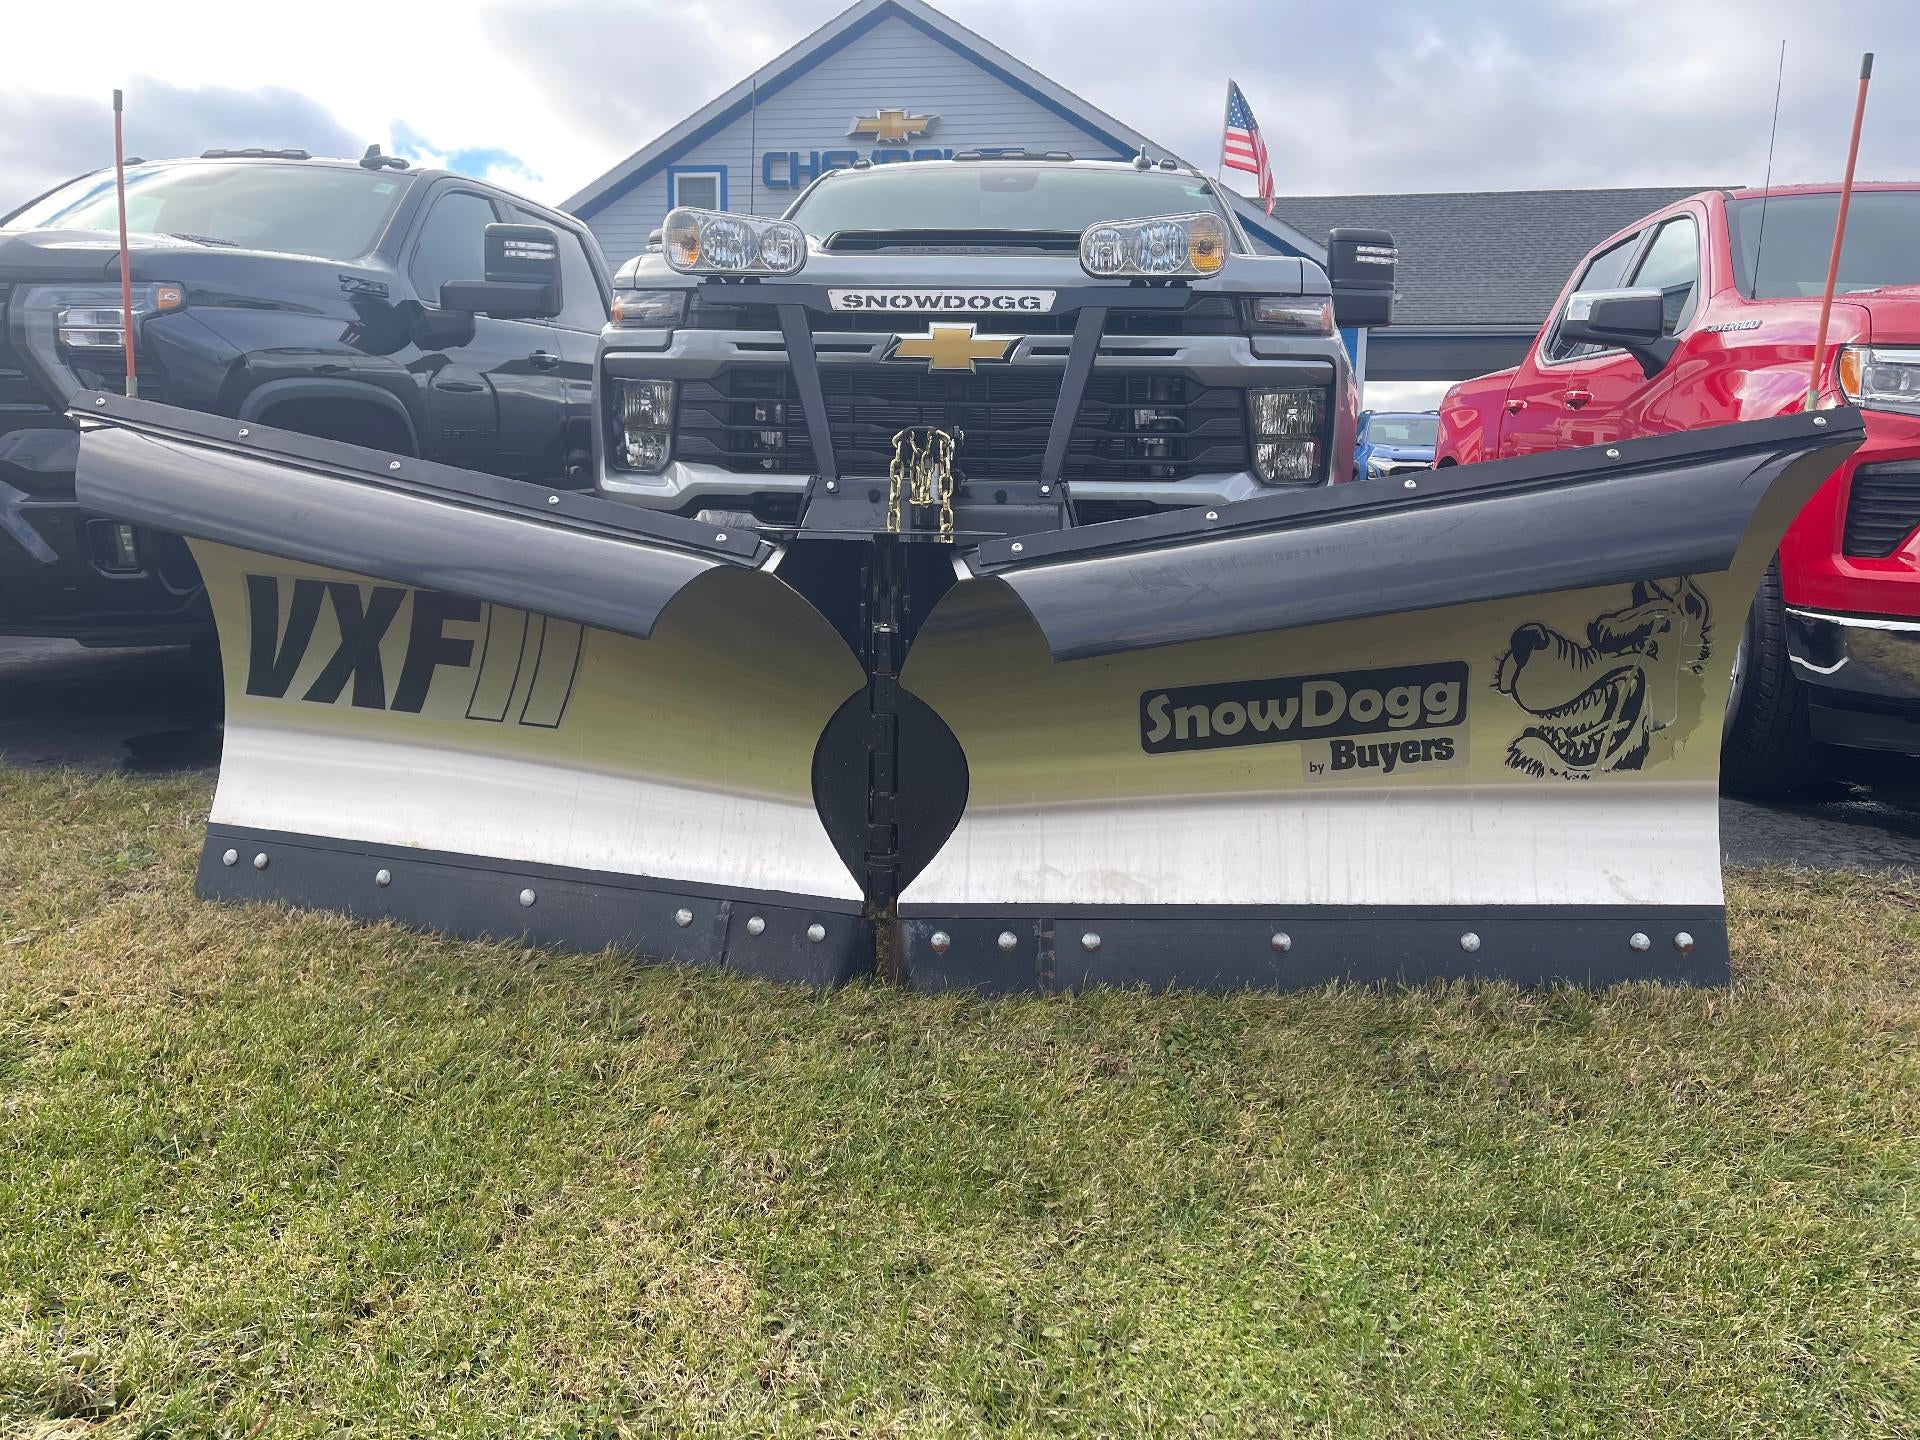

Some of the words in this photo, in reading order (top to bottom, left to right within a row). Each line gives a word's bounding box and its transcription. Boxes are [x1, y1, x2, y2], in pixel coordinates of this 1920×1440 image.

[842, 294, 1041, 310] SNOWDOGG
[1706, 320, 1763, 332] SILVERADO
[1146, 680, 1461, 744] SnowDogg
[1309, 761, 1325, 776] by
[1329, 737, 1455, 774] Buyers
